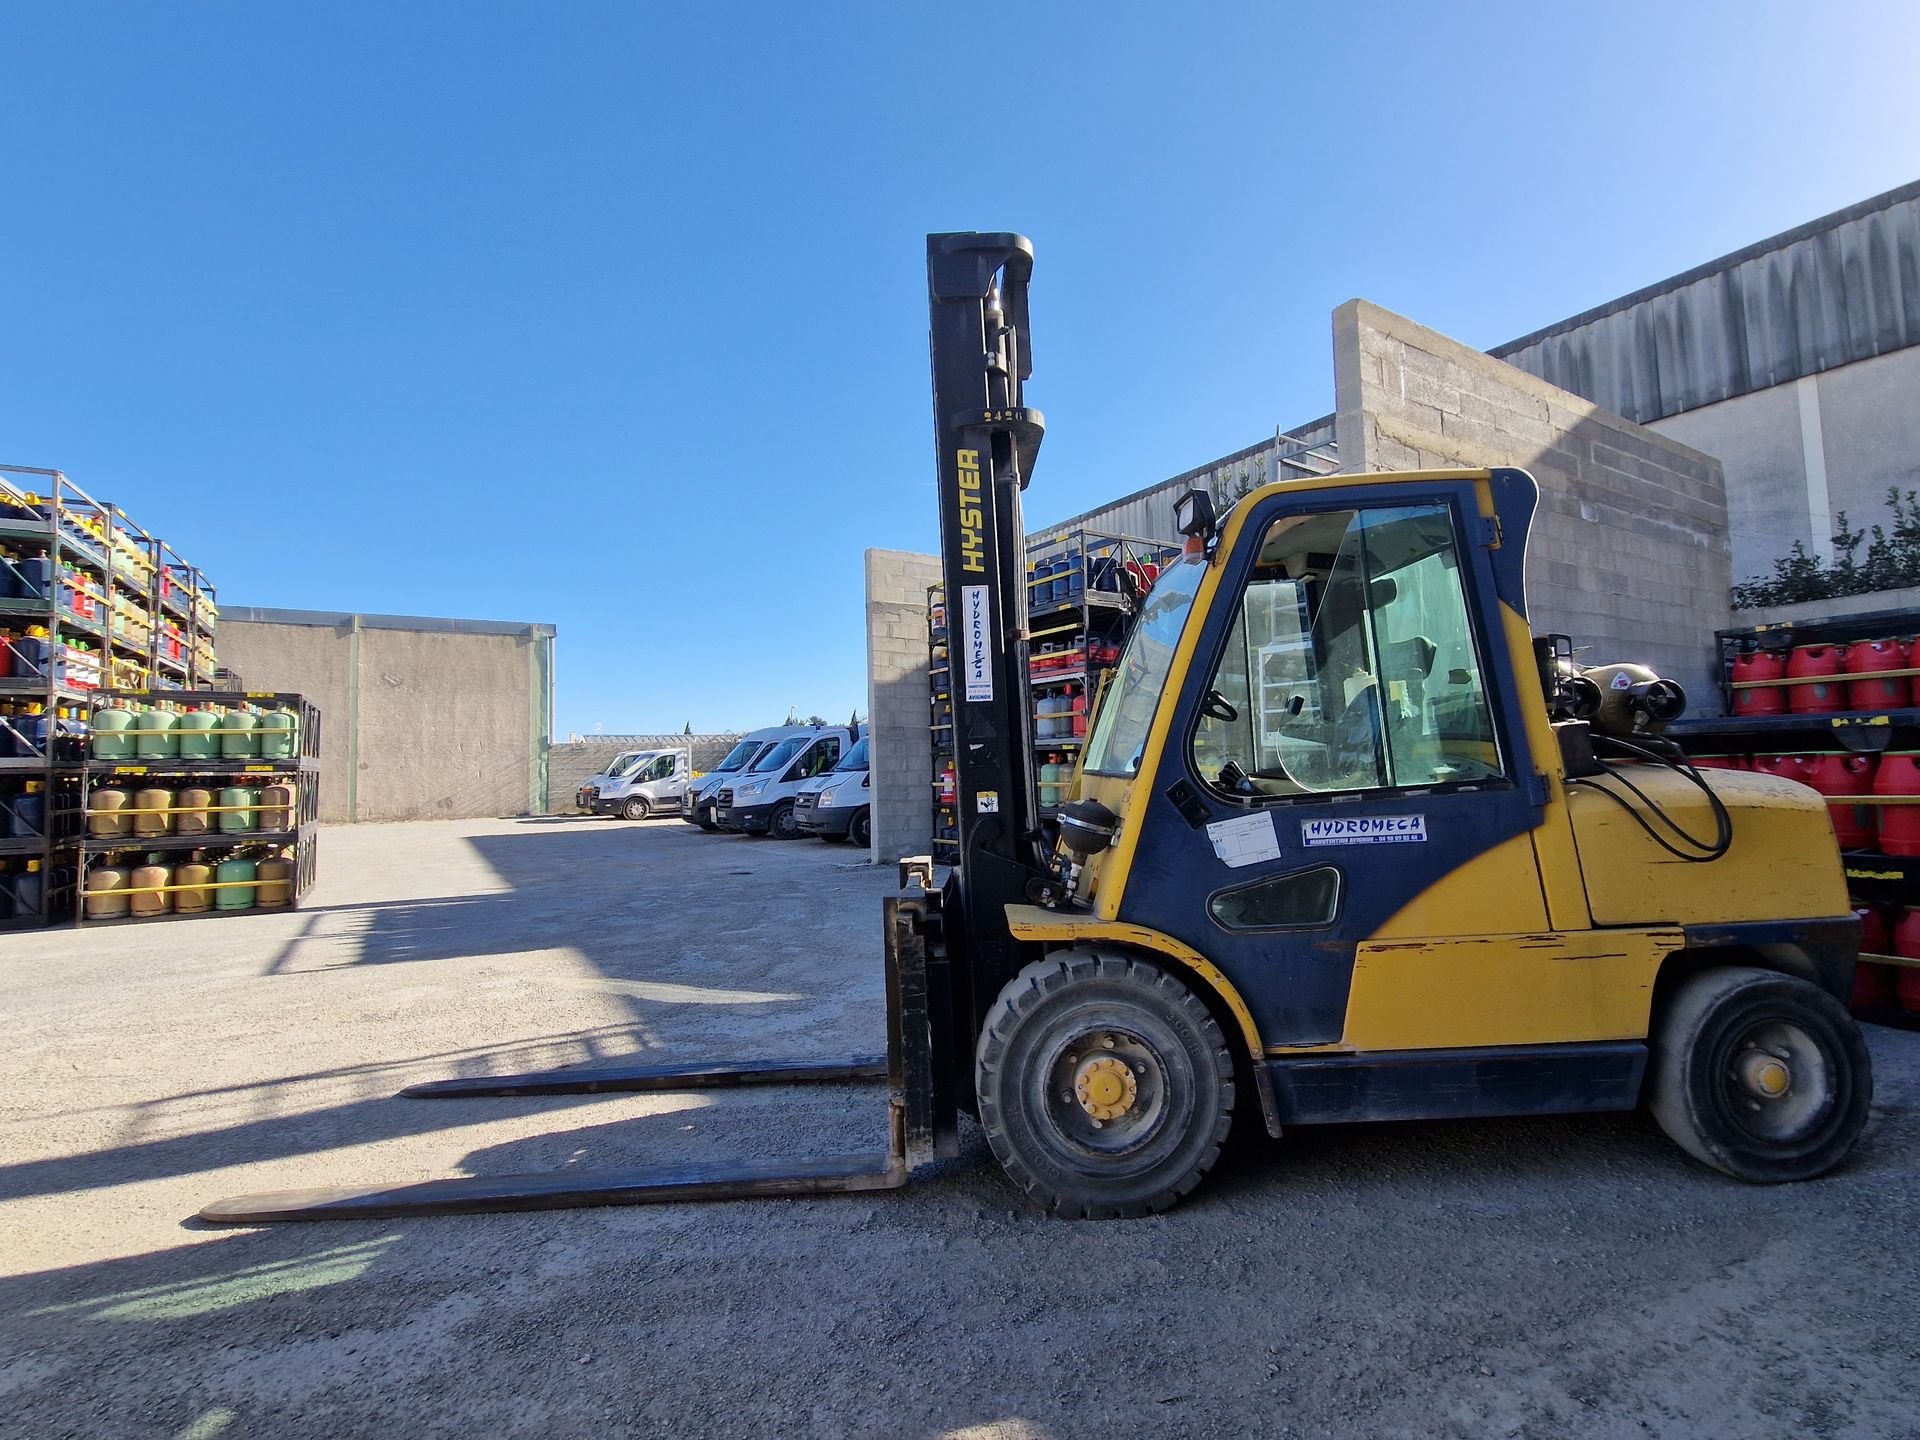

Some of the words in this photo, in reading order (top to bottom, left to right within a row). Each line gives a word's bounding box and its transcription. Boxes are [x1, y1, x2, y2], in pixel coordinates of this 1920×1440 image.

[957, 448, 985, 573] HYSTER
[970, 590, 985, 679] HYDROMECA
[1311, 817, 1420, 836] HYDROMECA
